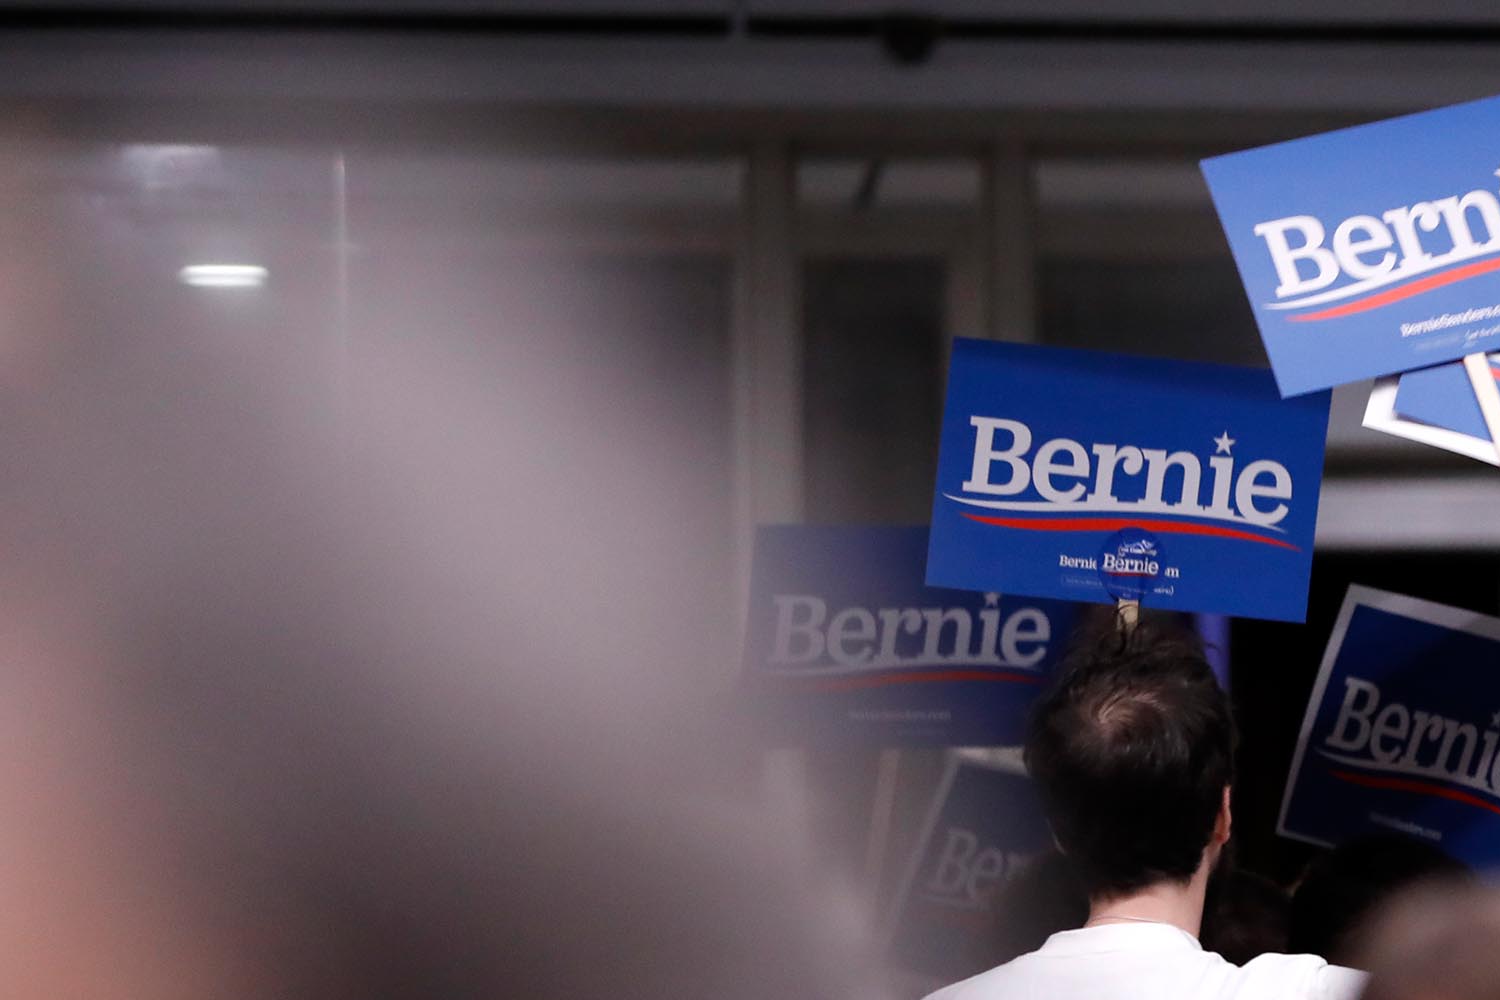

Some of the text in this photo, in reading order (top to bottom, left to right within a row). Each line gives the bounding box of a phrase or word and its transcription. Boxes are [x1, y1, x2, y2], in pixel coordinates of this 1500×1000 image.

[962, 415, 1293, 526] Bernie
[1102, 552, 1159, 575] Bernie
[767, 592, 1051, 668] Bernie
